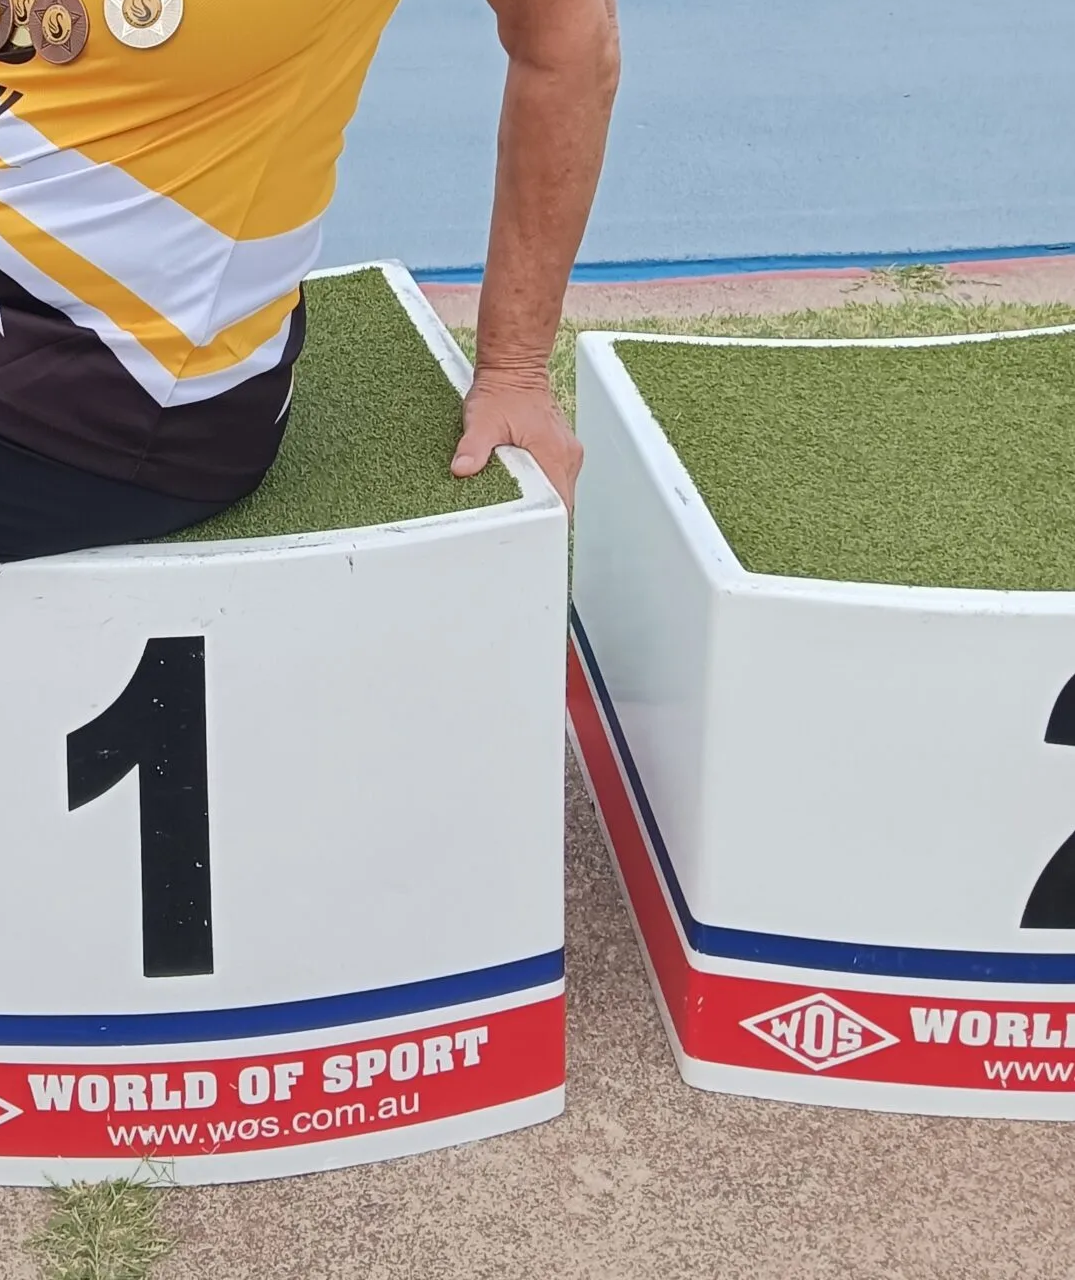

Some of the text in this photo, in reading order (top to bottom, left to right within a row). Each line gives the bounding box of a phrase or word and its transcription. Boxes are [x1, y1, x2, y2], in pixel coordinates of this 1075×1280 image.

[67, 636, 214, 977] 1
[770, 1005, 863, 1057] WOS
[27, 1025, 489, 1112] WORLD OF SPORT
[107, 1092, 420, 1146] www.wos.com.au
